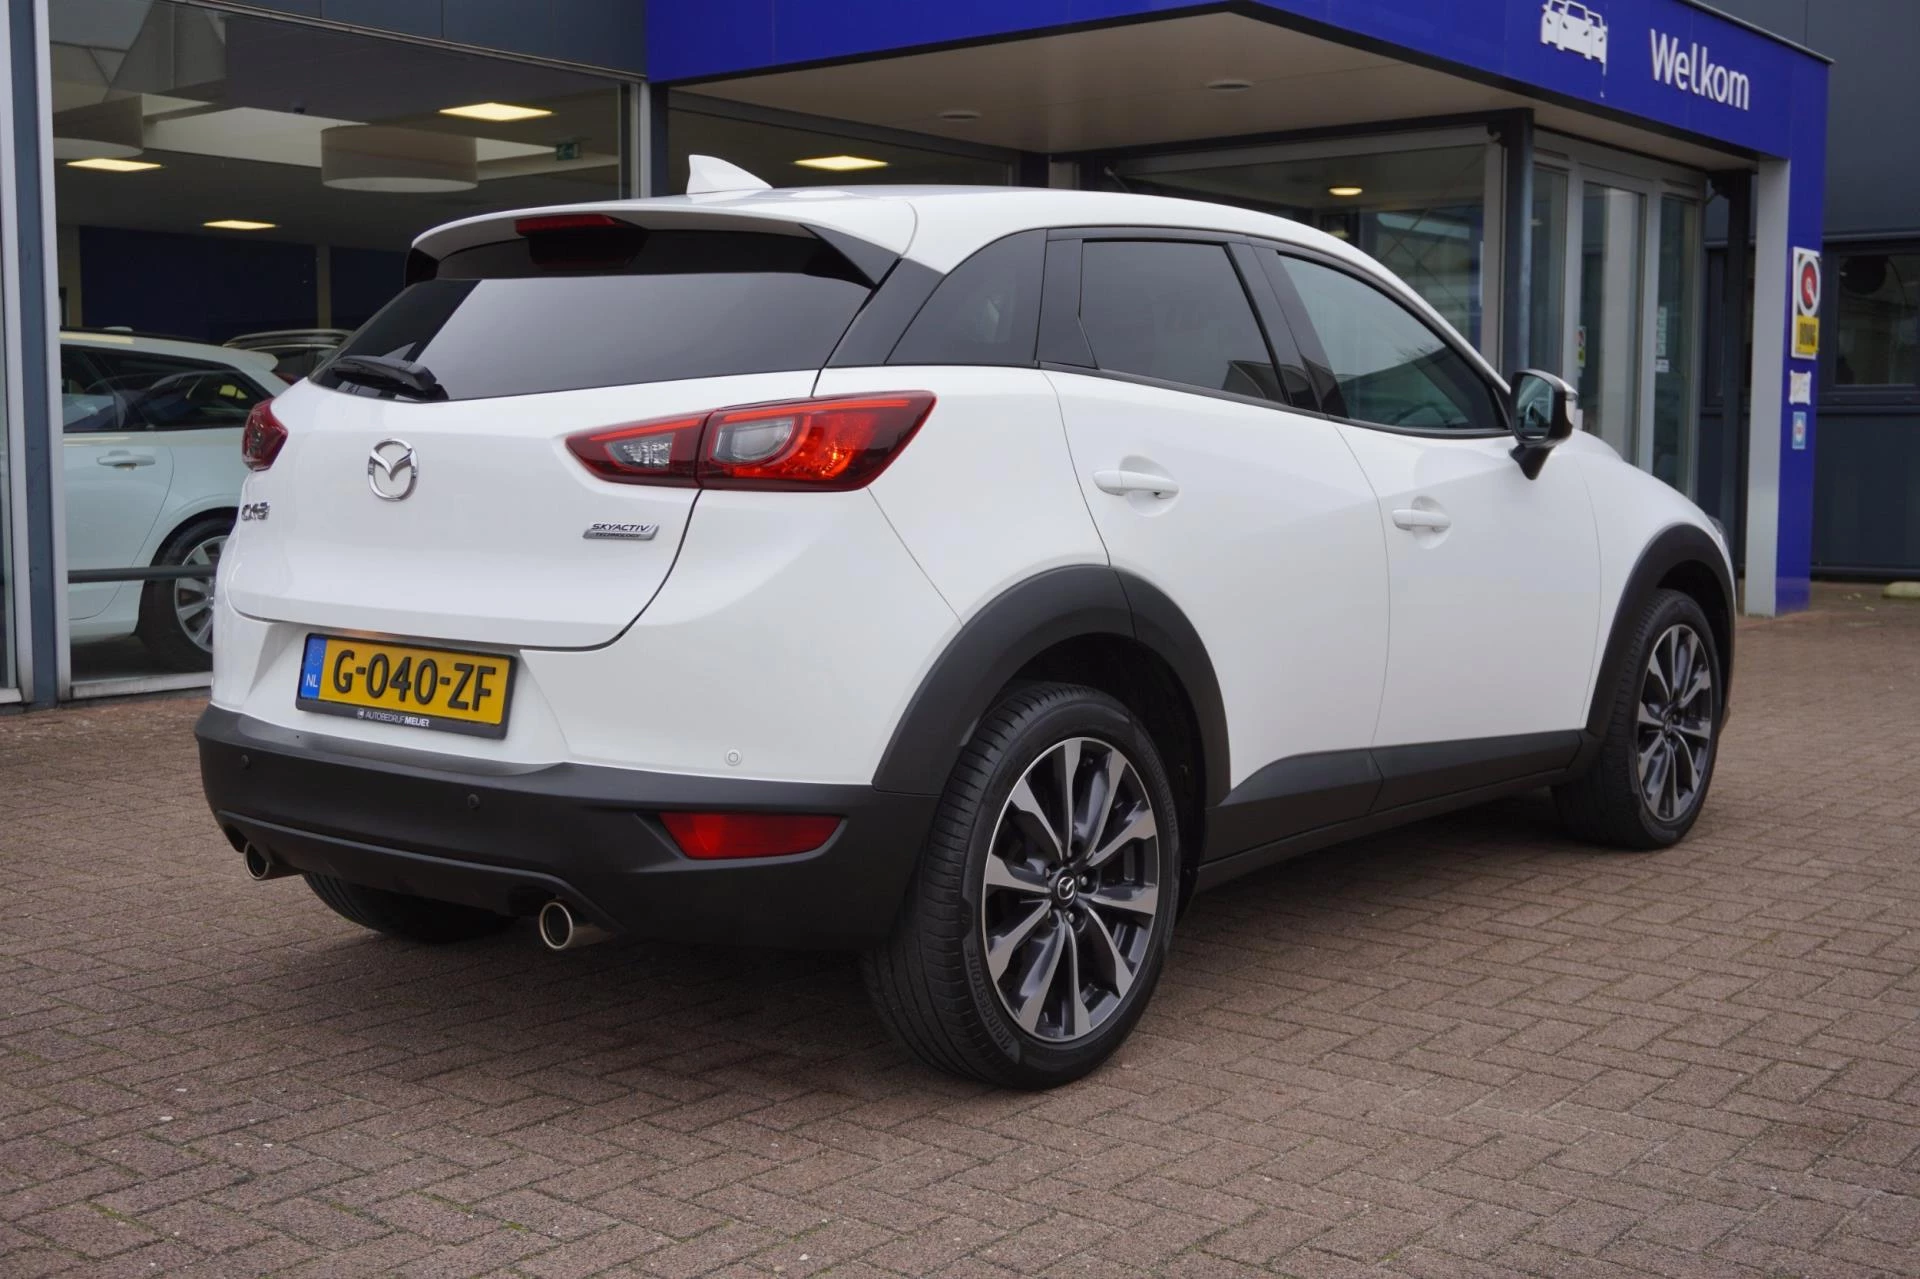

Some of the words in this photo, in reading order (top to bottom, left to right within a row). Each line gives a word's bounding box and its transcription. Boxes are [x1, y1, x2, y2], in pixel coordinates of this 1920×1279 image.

[1650, 28, 1749, 111] Welkom
[591, 523, 651, 532] SKYACTIV
[305, 673, 319, 688] NL
[333, 649, 497, 712] G-040-ZF
